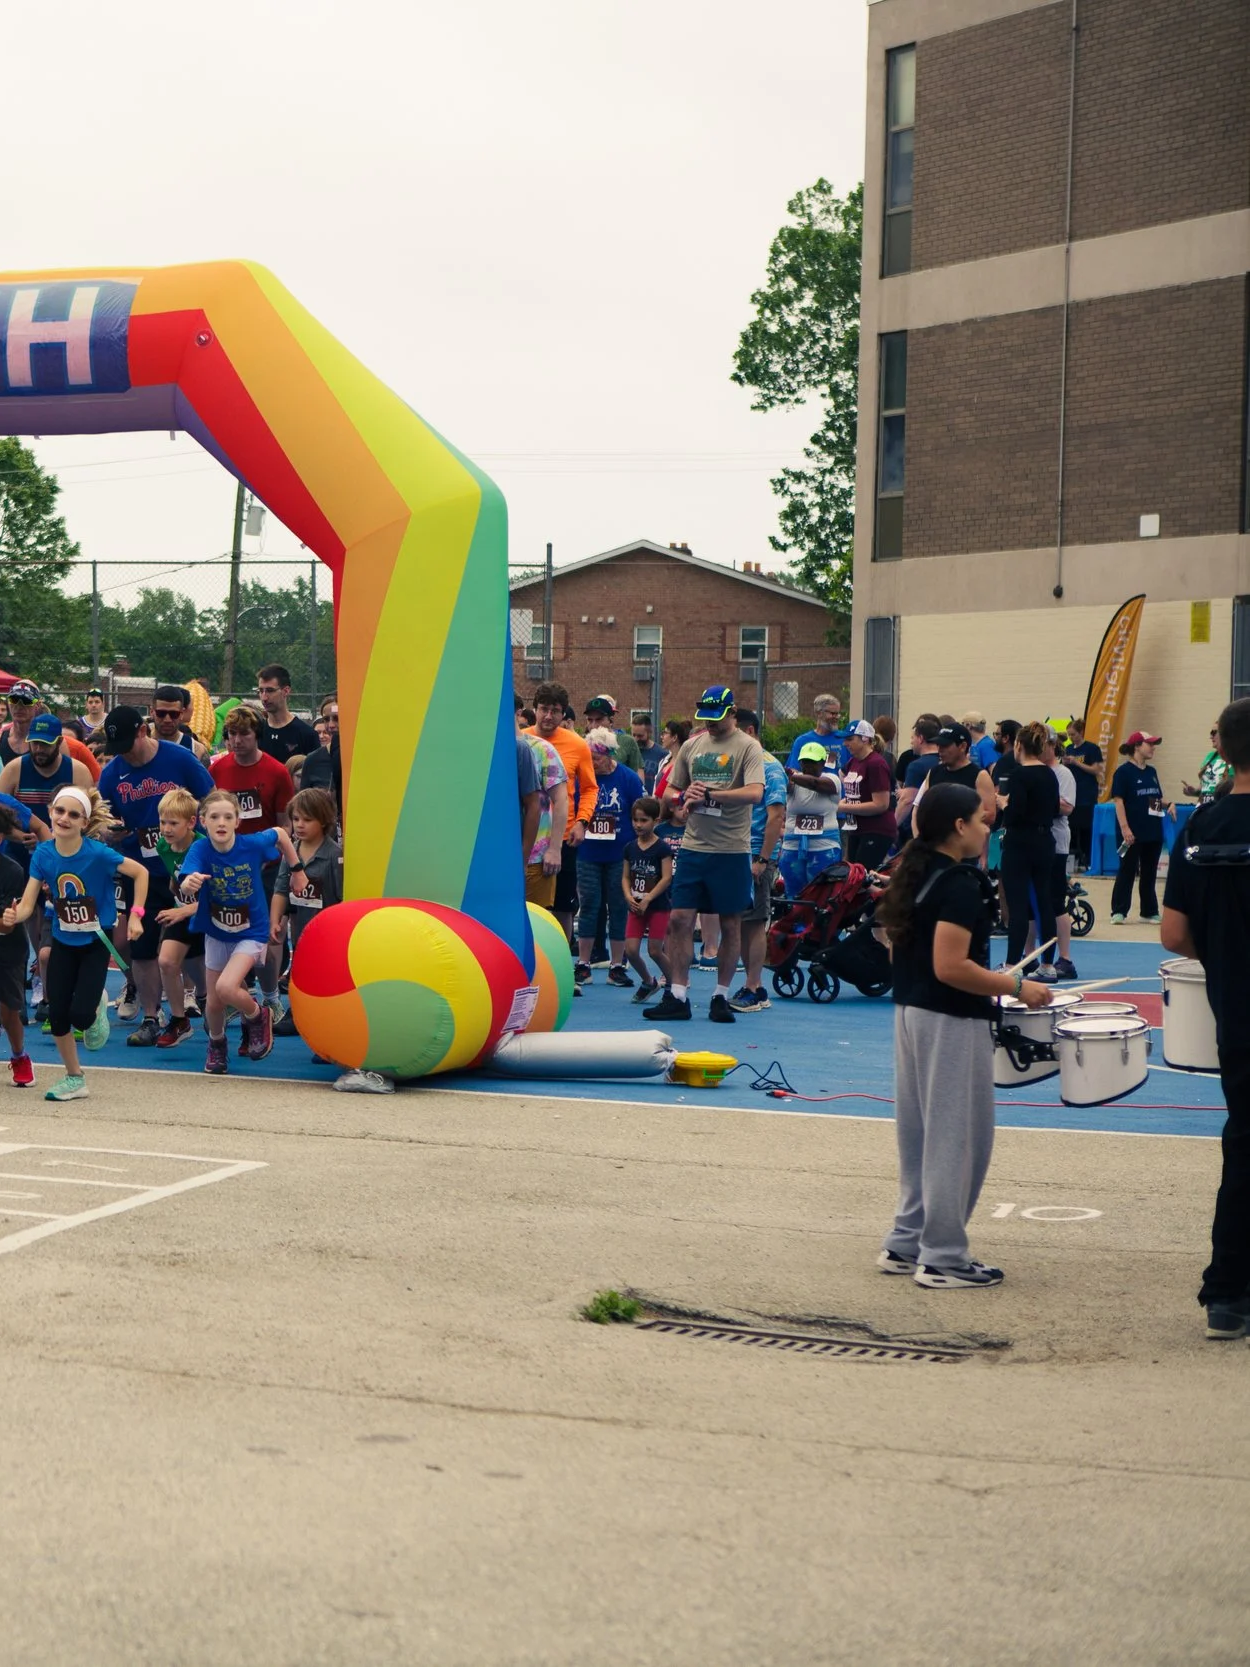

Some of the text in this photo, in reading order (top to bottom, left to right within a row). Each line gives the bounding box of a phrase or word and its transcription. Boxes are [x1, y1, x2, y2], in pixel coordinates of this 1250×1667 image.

[592, 821, 610, 833] 180
[801, 819, 818, 830] 223
[145, 831, 162, 847] 13
[298, 884, 316, 898] 62
[634, 879, 645, 892] 98
[64, 905, 89, 923] 150
[218, 911, 242, 926] 100
